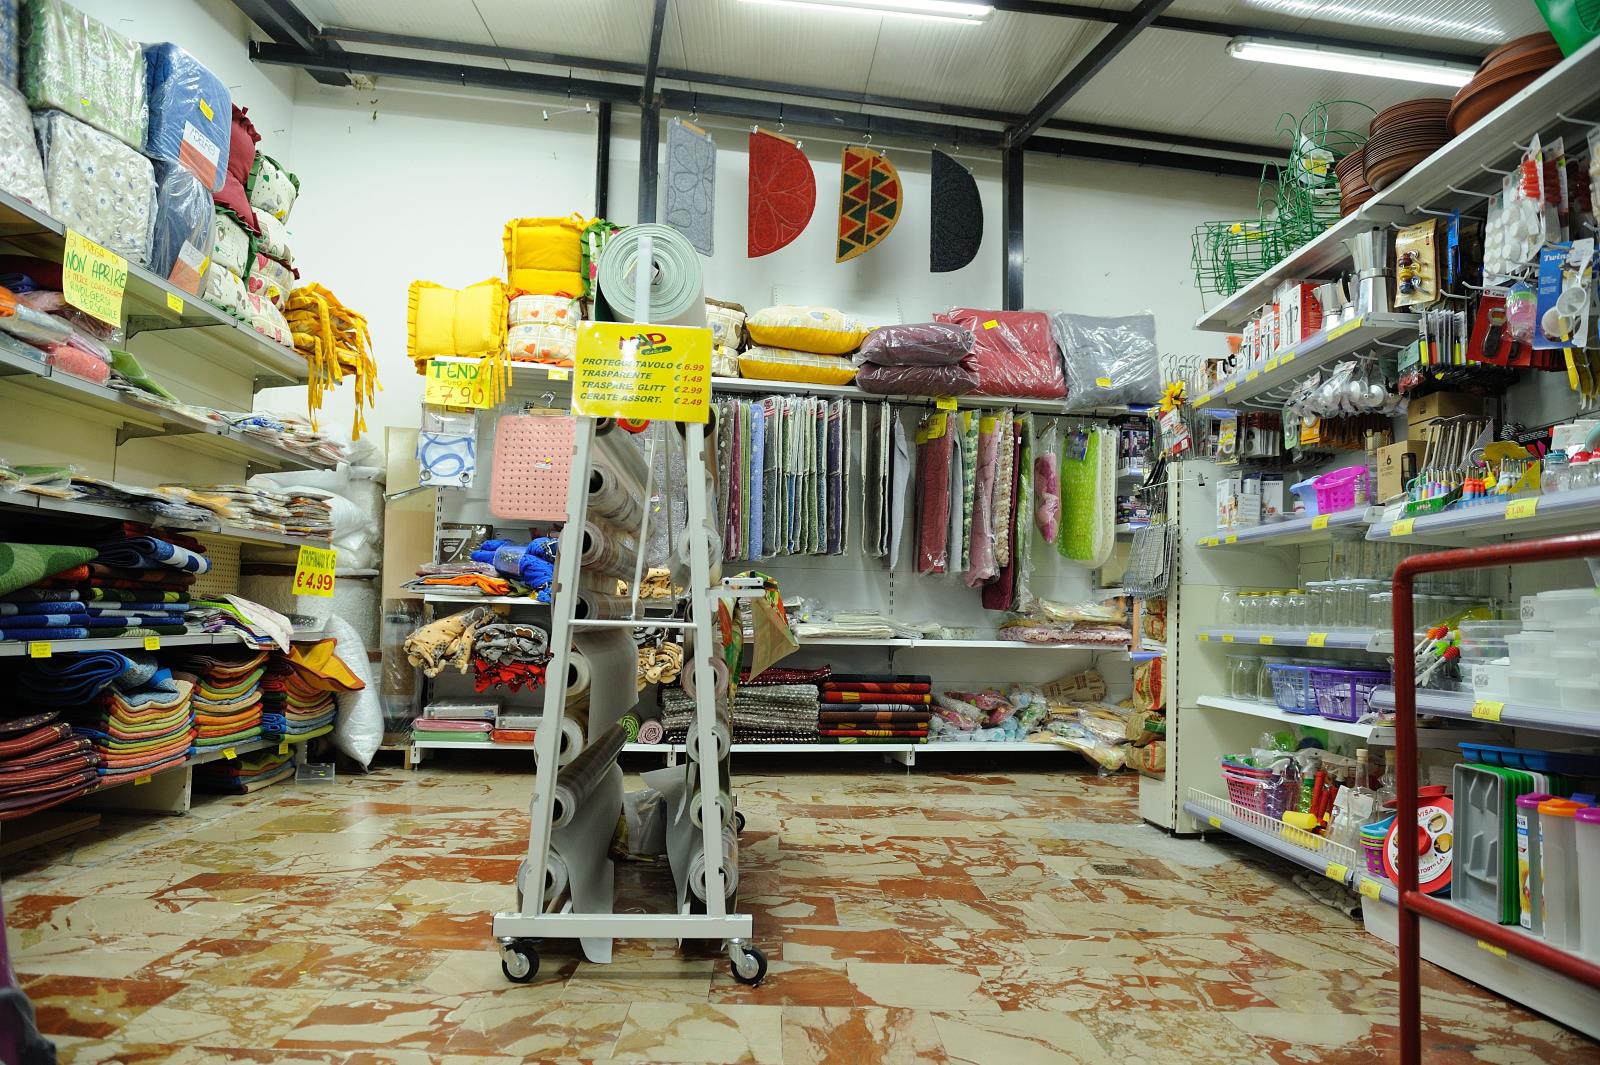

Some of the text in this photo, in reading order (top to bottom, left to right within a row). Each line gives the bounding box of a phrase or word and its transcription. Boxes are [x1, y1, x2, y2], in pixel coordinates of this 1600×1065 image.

[66, 250, 127, 288] NON APRIRE
[431, 361, 483, 380] TEND
[582, 358, 632, 367] PROTEGG
[636, 361, 673, 369] TAVOLO
[684, 363, 704, 371] 6.99
[582, 369, 702, 383] TRASPARENTE € 1.49
[638, 384, 666, 392] GLITT
[682, 386, 702, 394] 2.99
[580, 392, 702, 406] CERATE ASSORT. € 2.49
[1386, 455, 1392, 465] 6
[331, 554, 336, 570] 6
[297, 571, 333, 591] € 4.99
